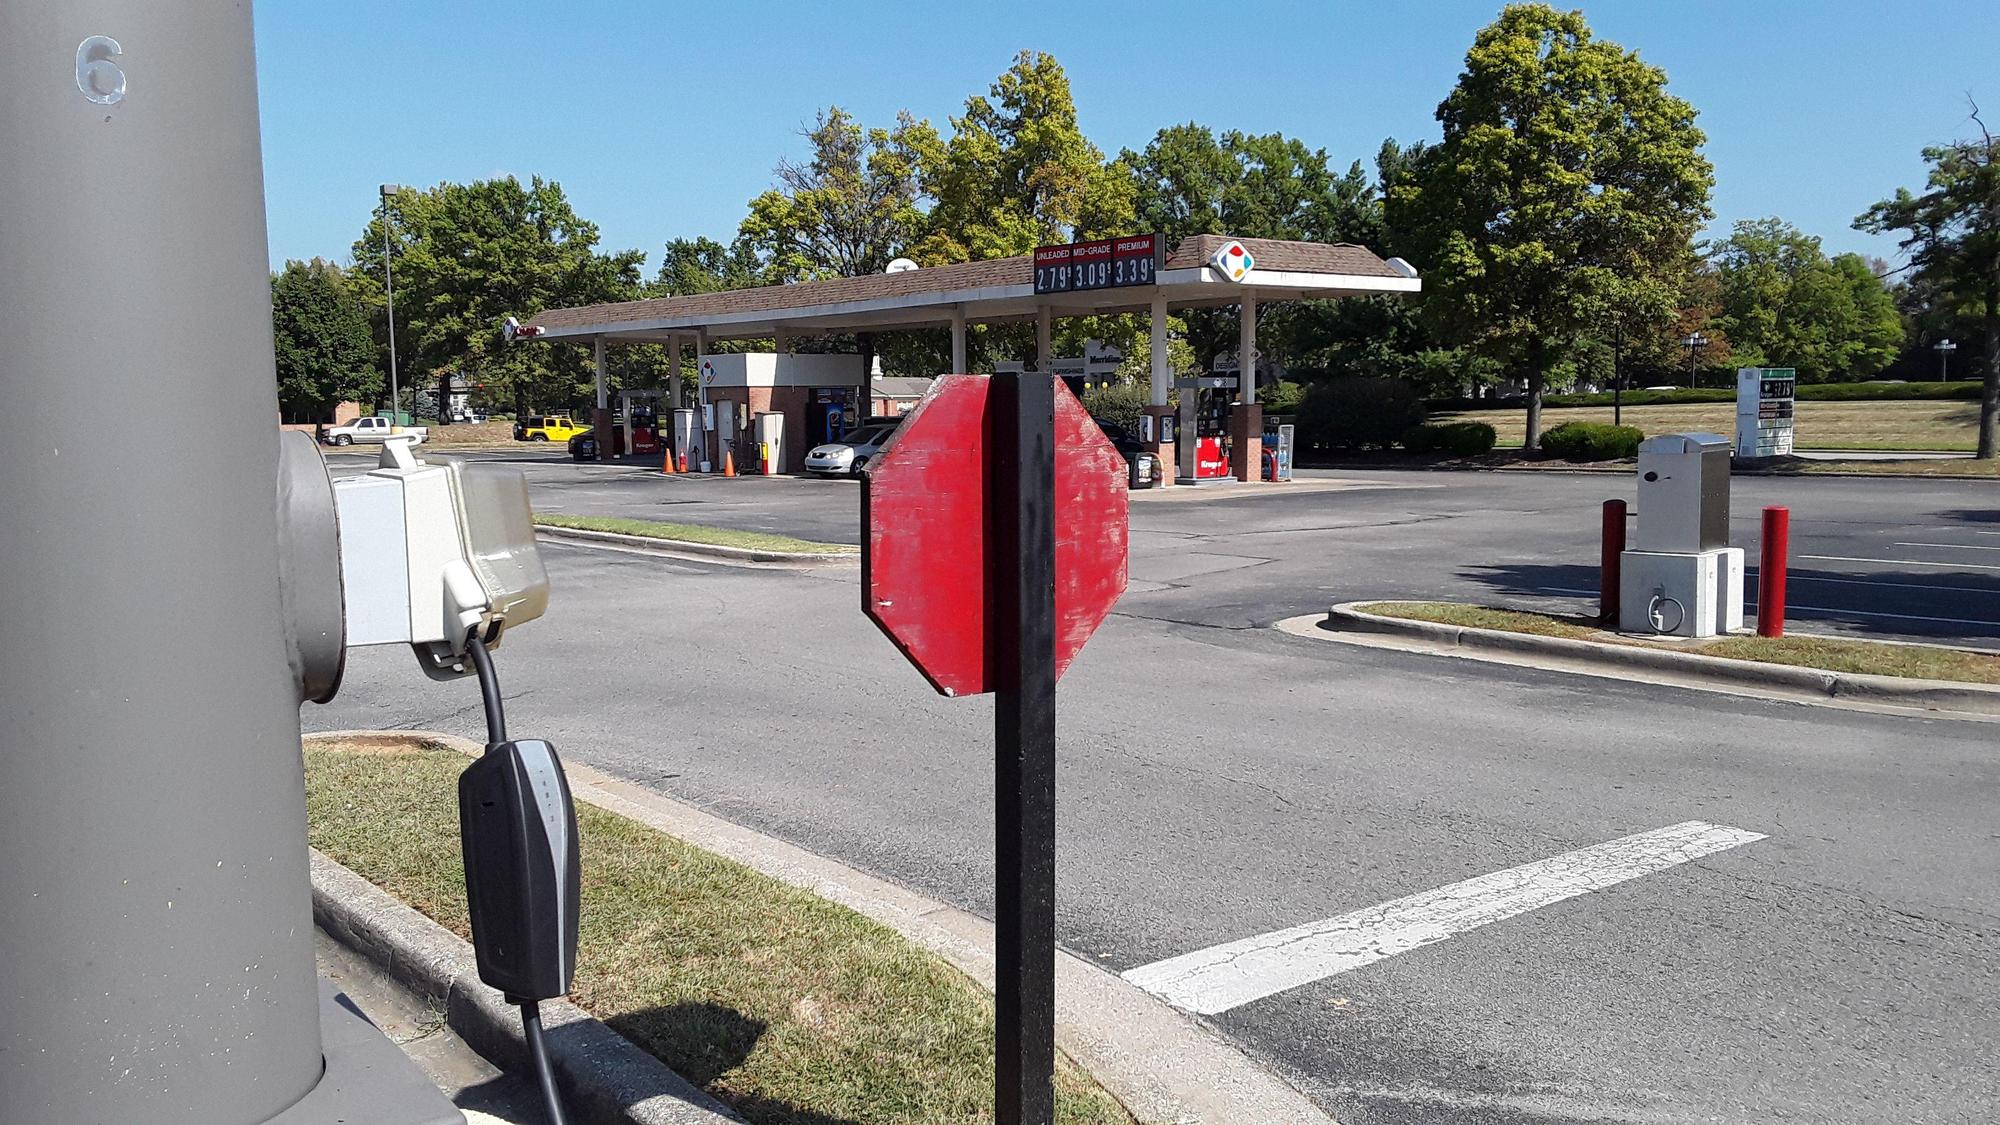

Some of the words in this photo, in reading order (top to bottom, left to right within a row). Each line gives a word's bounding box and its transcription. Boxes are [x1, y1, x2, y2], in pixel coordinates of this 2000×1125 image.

[76, 35, 127, 105] 6
[1073, 244, 1111, 256] MID-GRADE
[1117, 240, 1150, 252] PREMIUM
[1036, 249, 1070, 261] UNLEADED
